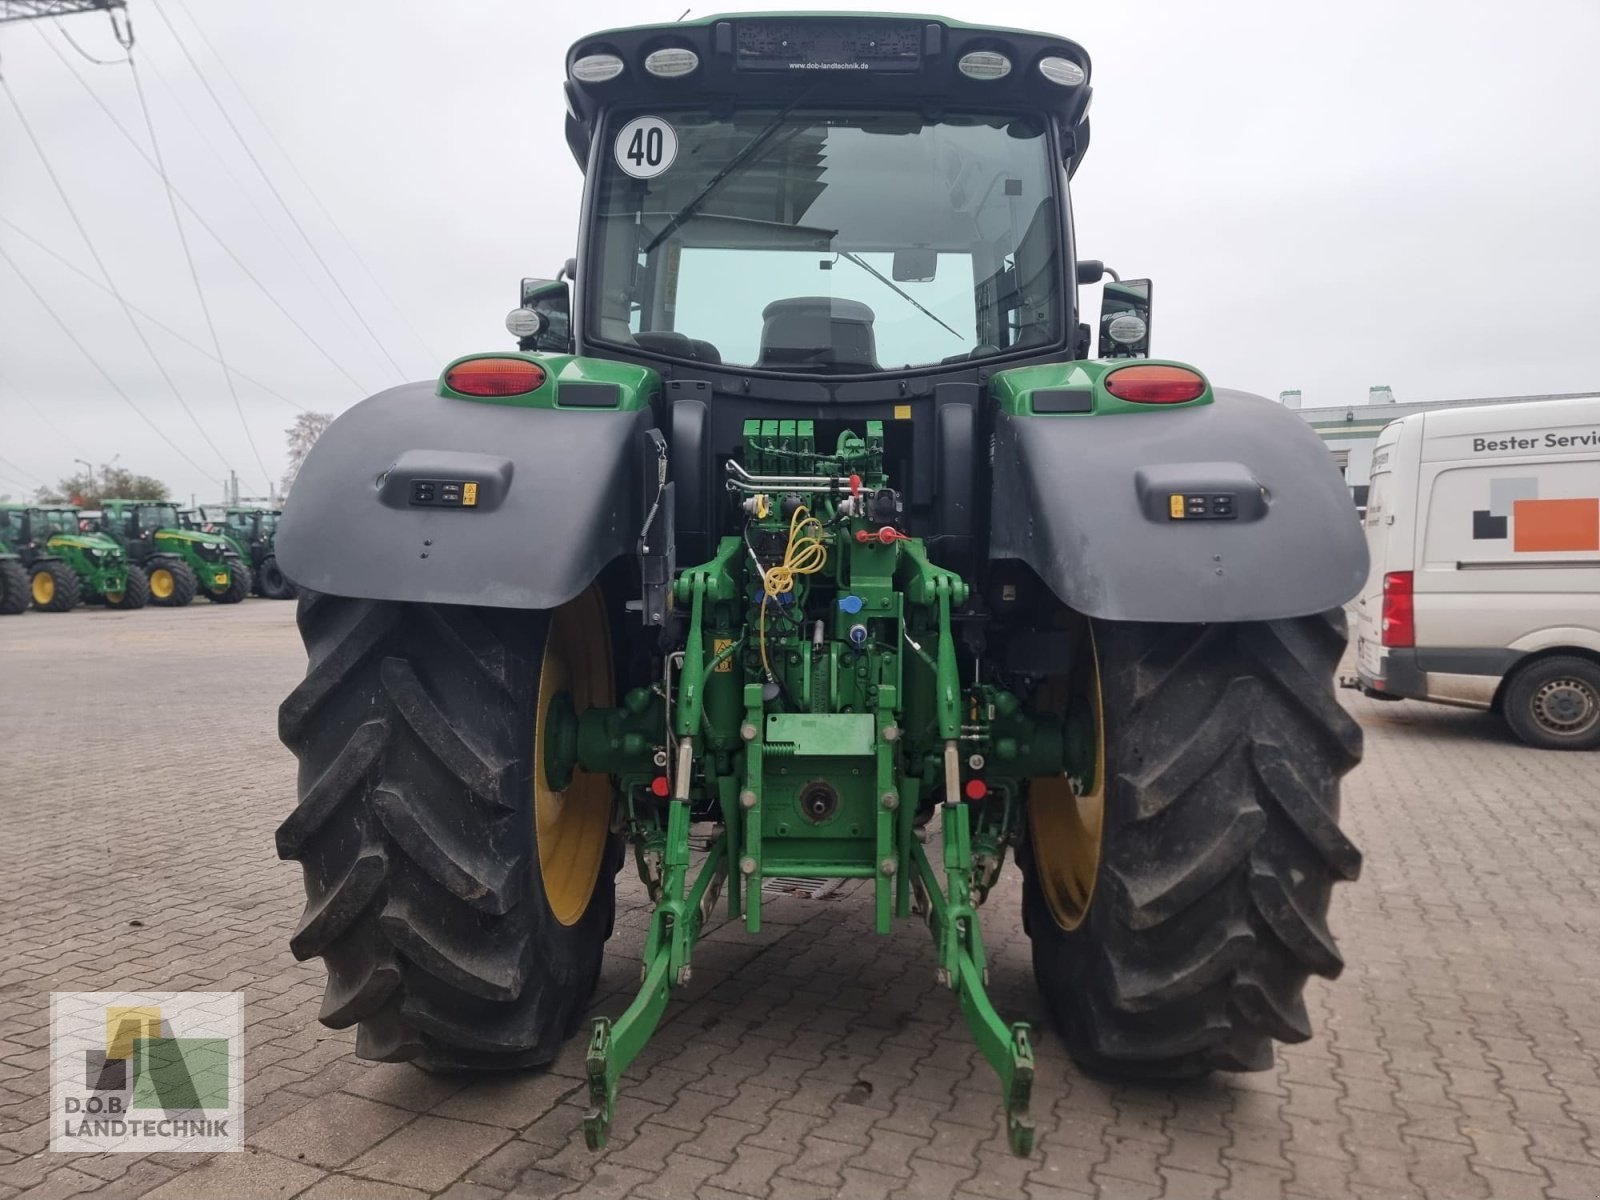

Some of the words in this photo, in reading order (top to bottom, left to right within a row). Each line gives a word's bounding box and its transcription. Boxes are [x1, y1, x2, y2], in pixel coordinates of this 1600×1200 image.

[788, 62, 869, 70] www.dob-landtechnik.de
[627, 127, 663, 166] 40
[1473, 436, 1539, 452] Bester
